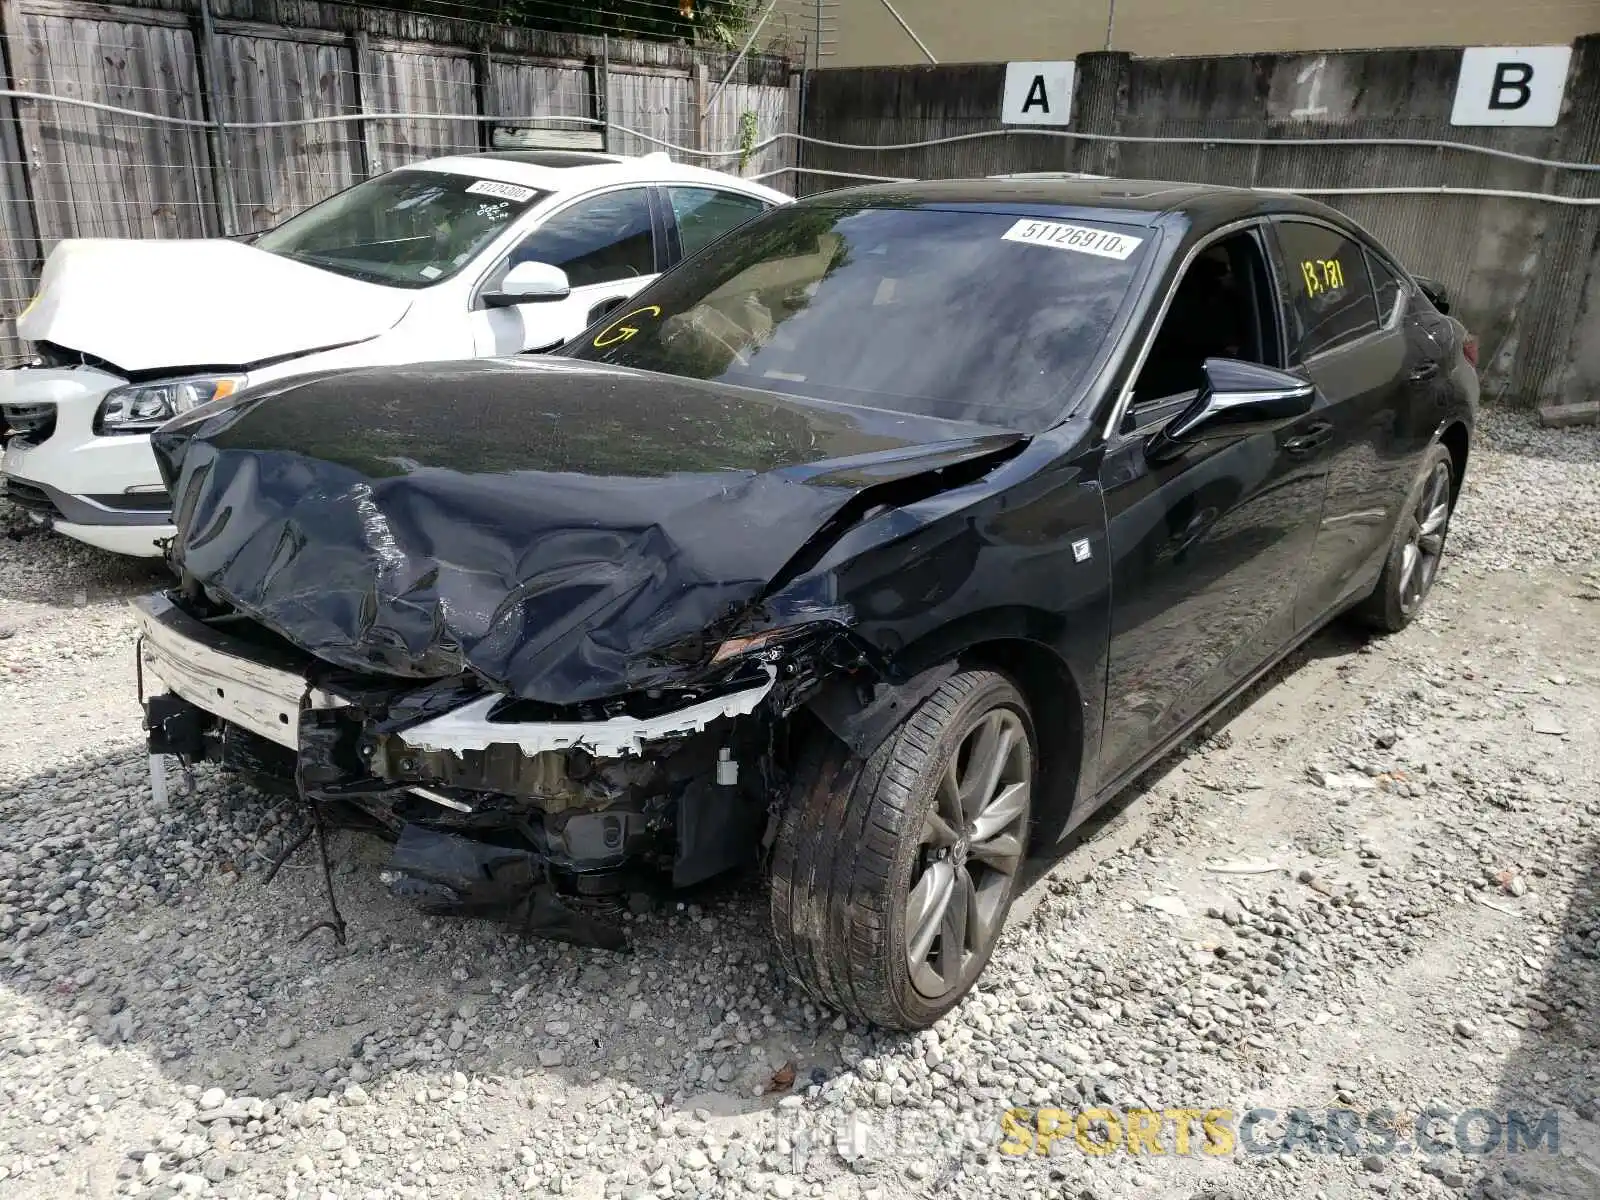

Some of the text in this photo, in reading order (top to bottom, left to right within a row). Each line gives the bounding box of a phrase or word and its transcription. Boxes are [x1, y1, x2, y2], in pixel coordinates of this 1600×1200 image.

[1021, 74, 1050, 113] A
[1290, 54, 1328, 117] 1
[1488, 62, 1534, 110] B
